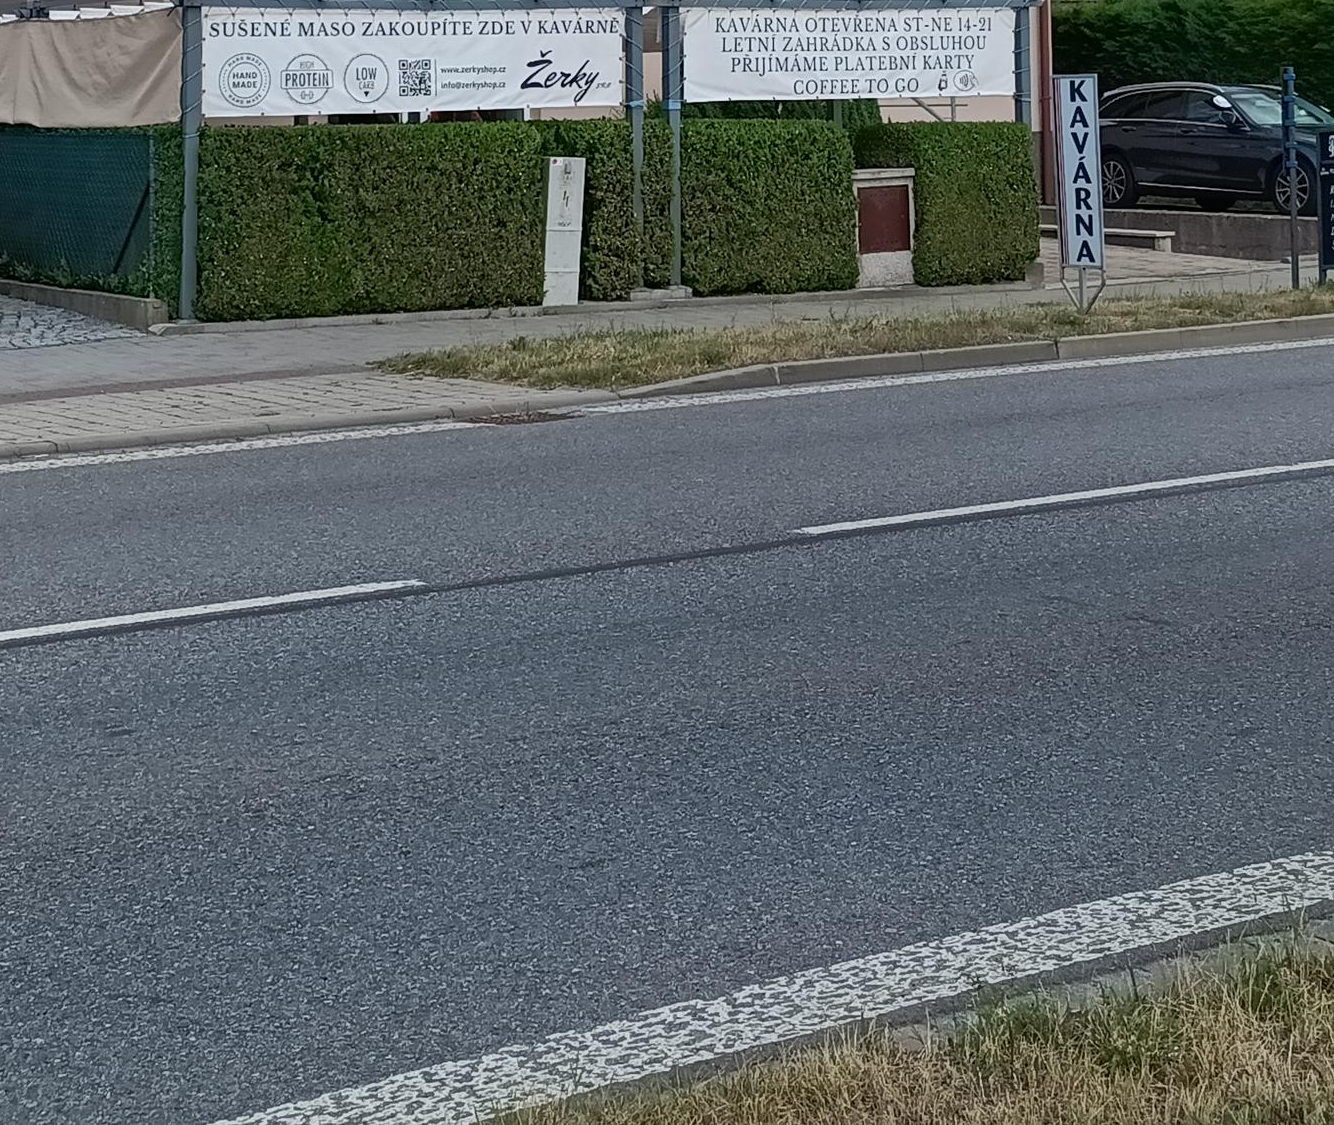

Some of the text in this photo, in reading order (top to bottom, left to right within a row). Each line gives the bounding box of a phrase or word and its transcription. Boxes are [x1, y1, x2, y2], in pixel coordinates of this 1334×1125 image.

[209, 17, 620, 37] SUŠENÉ MASO ZAKOUPÍTE ZDE V KAVÁRNĚ
[715, 13, 992, 33] KAVÁRNA OTEVŘENA ST-NE 14-21
[722, 33, 987, 53] LETNÍ ZAHRÁDKA S OBSLUHOU
[440, 64, 506, 74] www.zerkyshop.cz
[731, 53, 975, 76] PŘIJÍMÁME PLATEBNÍ KARTY
[285, 72, 329, 87] PROTEIN
[356, 67, 377, 81] LOW
[520, 50, 600, 102] Žerky
[232, 81, 258, 89] MADE
[441, 80, 506, 90] info@zerkyshop.cz
[793, 78, 919, 95] COFFEE TO GO
[1069, 79, 1096, 263] KAVÁRNA
